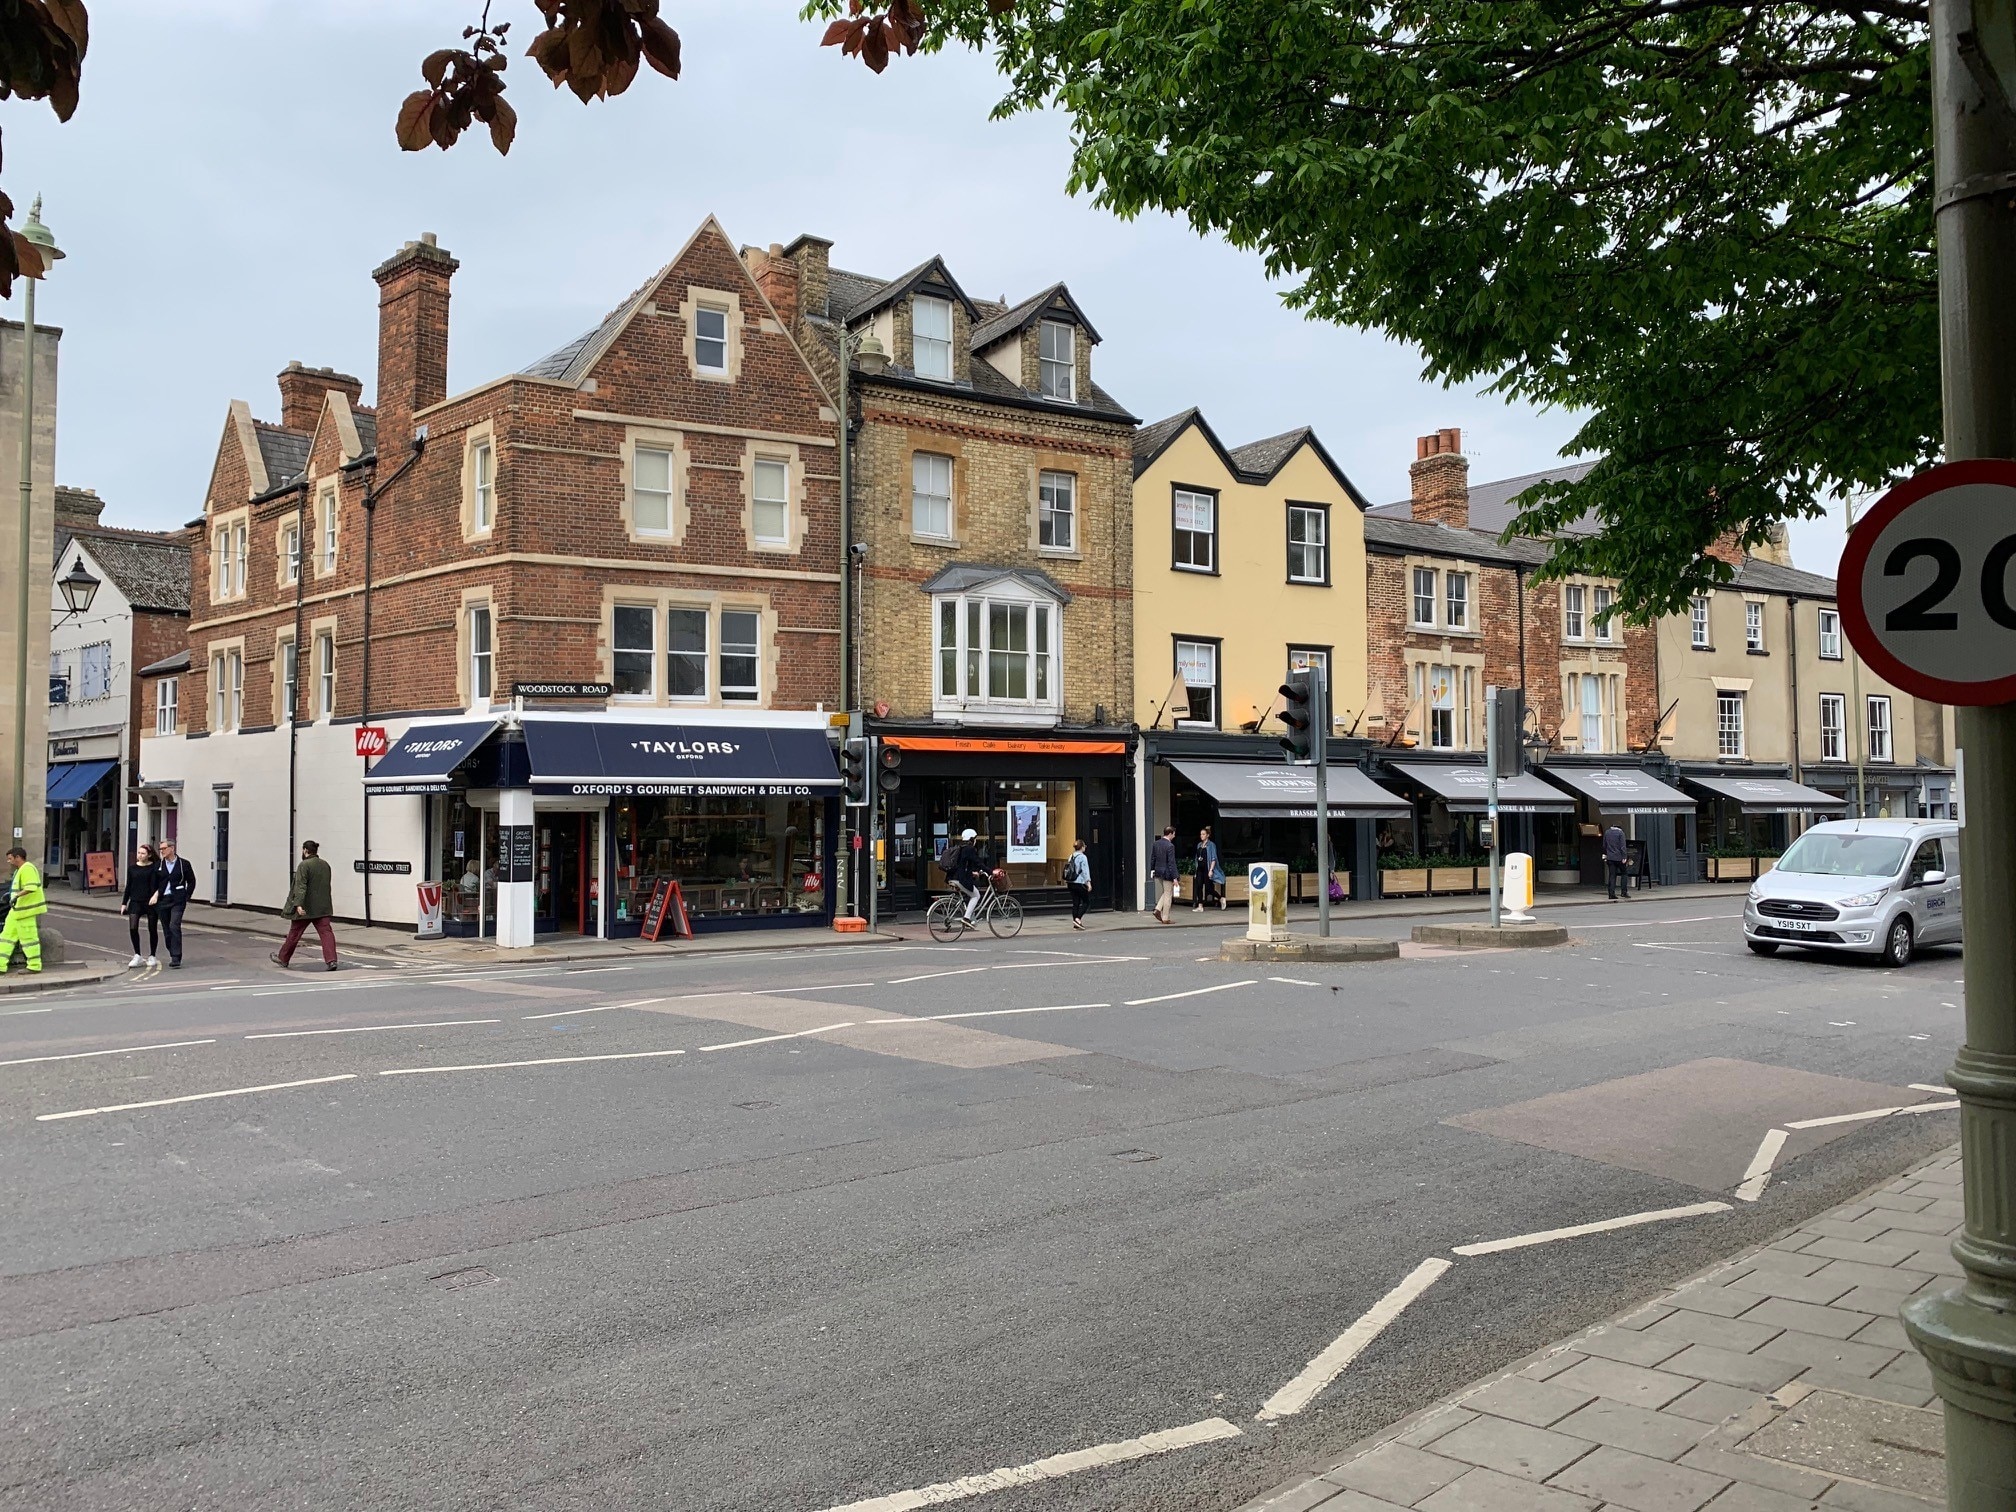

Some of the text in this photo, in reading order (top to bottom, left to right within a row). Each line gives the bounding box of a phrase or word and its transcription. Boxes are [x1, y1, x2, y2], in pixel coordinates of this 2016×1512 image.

[518, 684, 608, 694] WOODSTOCK ROAD
[357, 730, 384, 754] illy
[407, 739, 459, 754] TAYLORS
[639, 741, 733, 754] TAYLORS
[386, 785, 405, 793] GOURMET
[405, 784, 427, 792] SANDWICH
[1257, 779, 1317, 788] BROWNS
[572, 784, 812, 795] OXFORD'S GOURMET SANDWICH & DELI CO.
[368, 863, 394, 871] CLARENDON
[395, 864, 410, 872] STREET
[804, 874, 820, 889] illy
[1926, 896, 1946, 909] BIRCH
[1777, 920, 1811, 930] YS19 SXT
